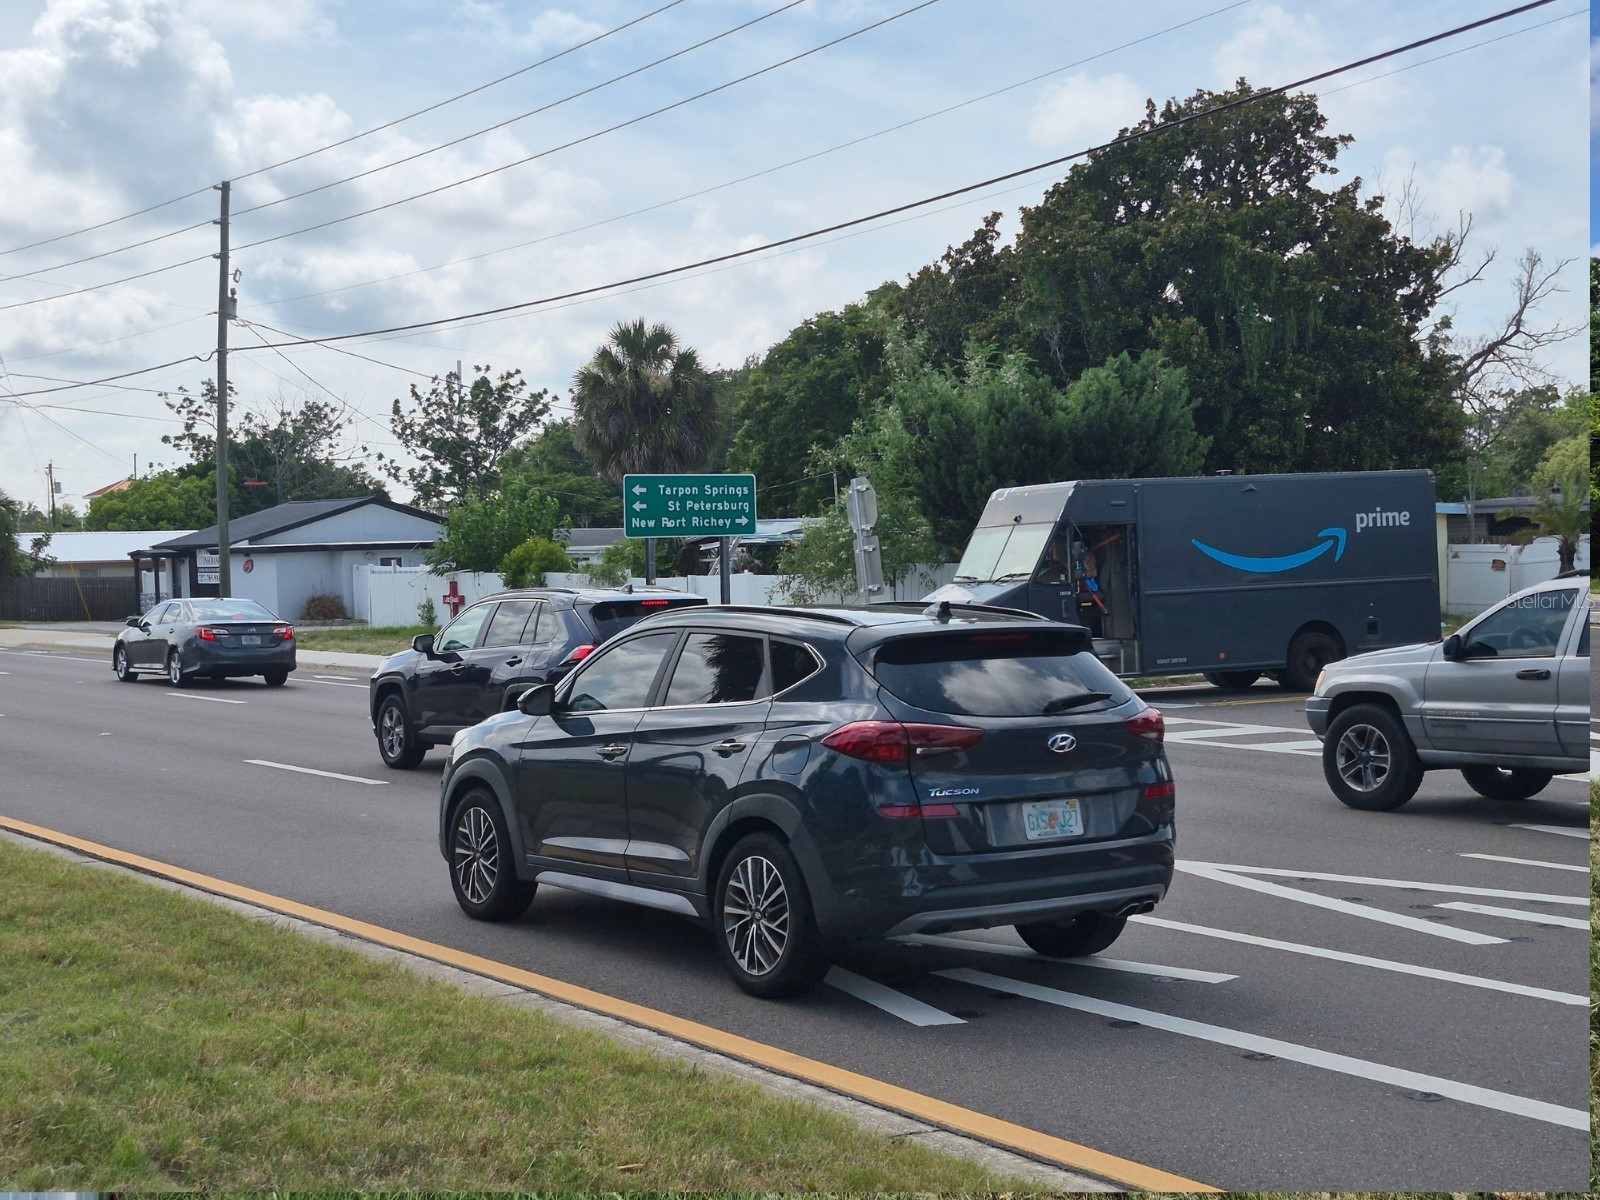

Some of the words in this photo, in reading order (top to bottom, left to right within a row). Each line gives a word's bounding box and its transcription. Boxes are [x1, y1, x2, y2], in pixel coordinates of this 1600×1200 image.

[658, 484, 699, 497] Tarpon
[704, 484, 749, 497] Springs
[668, 501, 680, 511] St
[686, 500, 749, 513] Petersburg
[631, 518, 656, 528] New
[661, 516, 686, 528] Port
[692, 516, 731, 529] Richey
[1356, 507, 1410, 533] prime
